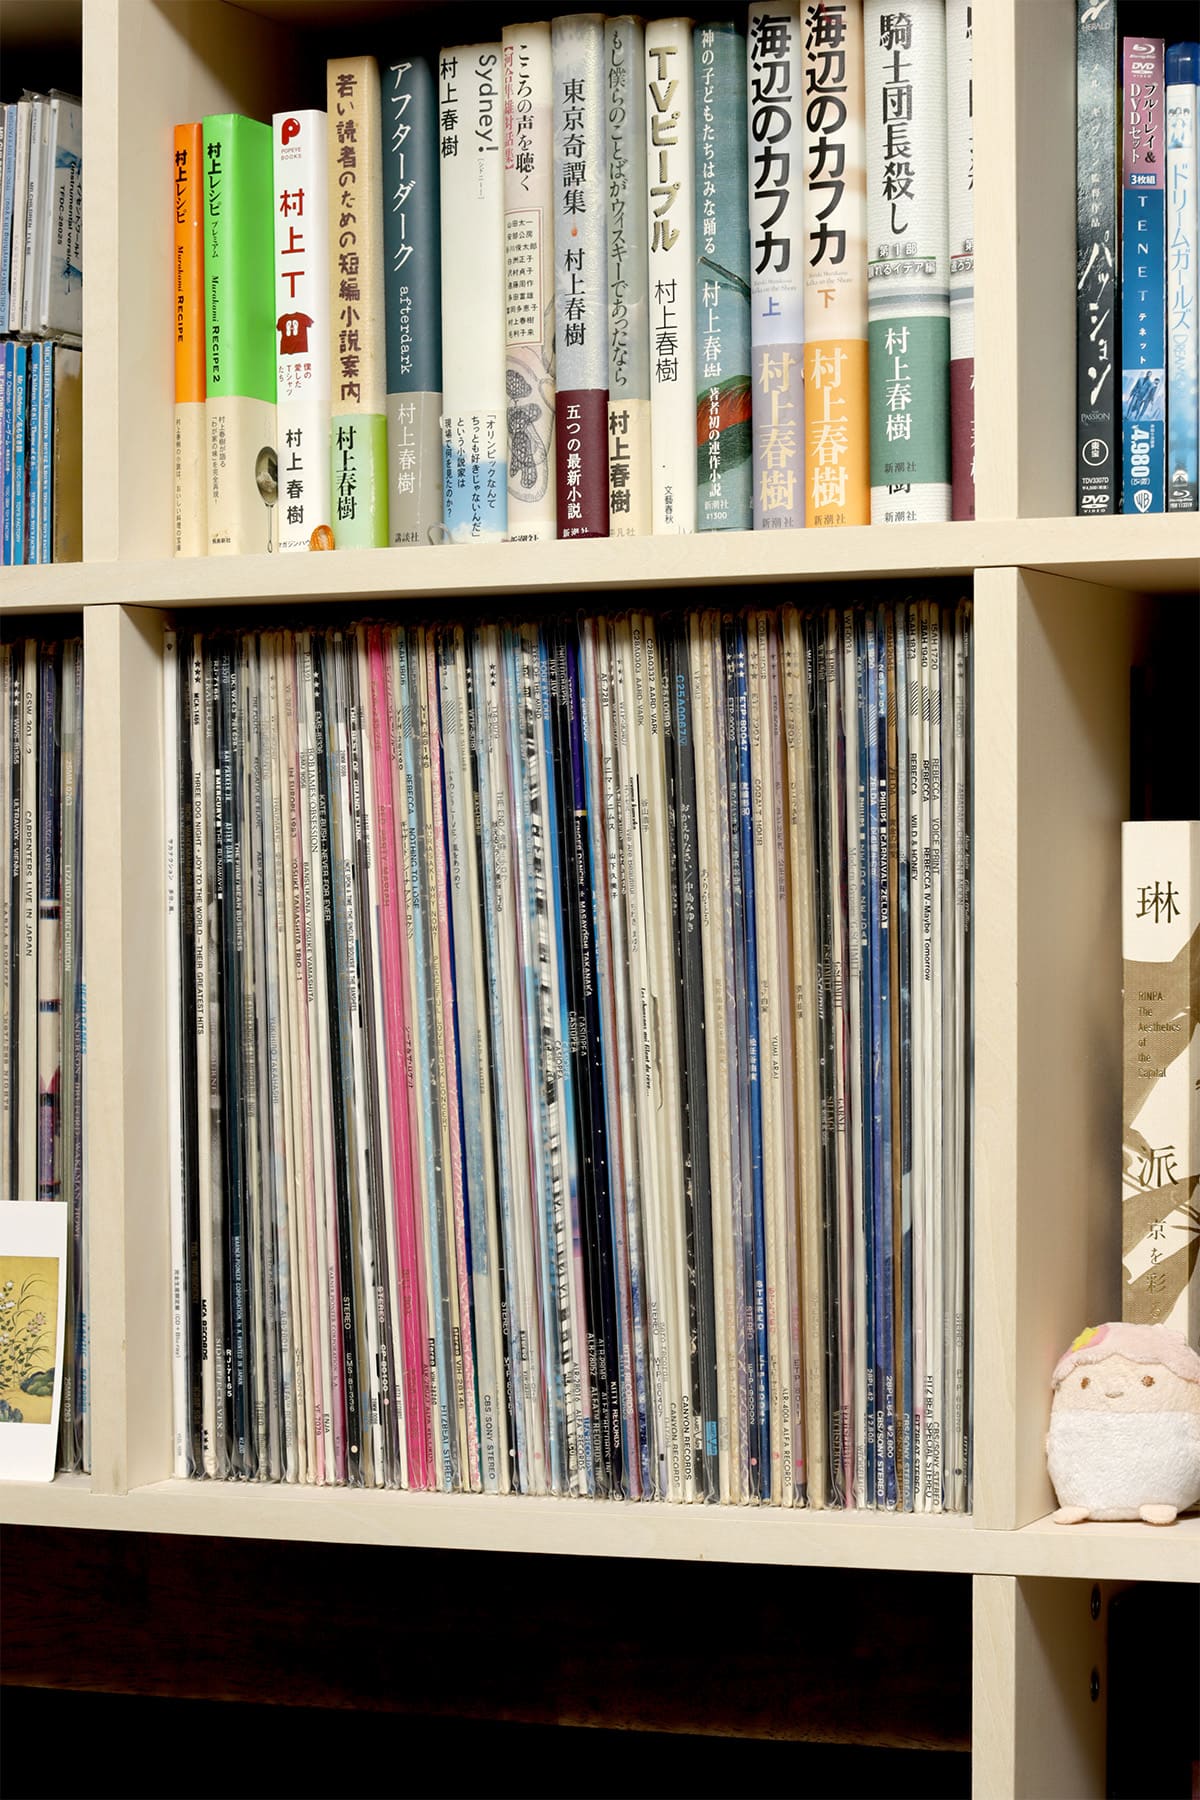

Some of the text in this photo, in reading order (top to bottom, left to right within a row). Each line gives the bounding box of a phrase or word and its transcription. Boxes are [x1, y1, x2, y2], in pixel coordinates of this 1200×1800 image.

[440, 56, 458, 158] 村上春樹
[475, 54, 498, 153] Sydney!
[1132, 62, 1155, 71] DVD
[515, 44, 534, 192] こころの声を聴く
[562, 78, 587, 216] 東京奇譚集
[648, 46, 681, 253] TVピープル
[701, 30, 716, 254] 神の子どもたちはみな踊る
[751, 14, 792, 275] 海辺のカフカ
[805, 3, 848, 267] 海辺のカフカ
[879, 12, 916, 234] 騎士団長殺し
[1129, 84, 1142, 164] DVDセット
[1142, 84, 1158, 164] ブルーレイ&
[175, 150, 188, 224] 村上レシピ
[208, 142, 222, 216] 村上レシピ
[390, 62, 416, 272] アフターダーク
[608, 30, 628, 386] もし僕らのことばがウィスキーであったなら
[1130, 174, 1156, 185] 3枚組
[280, 188, 305, 298] 村上T
[336, 74, 362, 404] 若い読者のための短編小説案内
[1170, 163, 1193, 330] ドリームガールズ
[212, 275, 220, 383] Murakami RECIPE 2
[399, 286, 413, 374] afterdark
[564, 248, 586, 348] 村上春樹
[654, 278, 678, 383] 村上春樹
[762, 296, 781, 317] 上
[817, 289, 836, 308] 下
[1077, 230, 1112, 406] パッション
[1138, 312, 1148, 365] テネット
[294, 363, 302, 388] 愛した
[885, 326, 912, 442] 村上春樹
[398, 402, 416, 496] 村上春樹
[456, 418, 466, 488] という小説家は
[486, 414, 496, 508] 「オリンピックなんて
[566, 404, 582, 520] 五つの最新小説
[610, 410, 631, 514] 村上春樹
[708, 387, 722, 498] 著者初の連作小説
[758, 352, 796, 512] 村上春樹
[810, 347, 848, 508] 村上春樹
[884, 462, 917, 473] 新潮社
[286, 428, 304, 525] 村上春樹
[336, 426, 358, 521] 村上春樹
[472, 416, 481, 538] ちっとも好きじゃないんだ」
[884, 510, 918, 522] 新潮社
[1082, 494, 1110, 504] DVD
[762, 516, 794, 528] 新潮社
[814, 514, 846, 525] 新潮社
[921, 619, 929, 667] 28AH 1940
[352, 761, 358, 772] OF
[739, 696, 747, 751] ETP-80047
[922, 760, 930, 802] REBECCA
[196, 873, 202, 885] TO
[406, 774, 420, 909] REBECCA NOTHING TO LOSE
[932, 849, 940, 874] PRINT
[26, 909, 32, 918] IN
[303, 862, 311, 914] BANSLIKANA
[1136, 880, 1180, 924] 琳
[569, 1011, 577, 1053] CASIOPEA
[1138, 1007, 1153, 1016] The
[1138, 1022, 1182, 1032] Aesthetics
[1138, 1038, 1148, 1046] of
[1138, 1054, 1151, 1062] the
[1137, 1145, 1178, 1188] 派
[610, 1381, 620, 1448] KITTY RECORDS
[876, 1410, 885, 1496] CBS/SONY STEREO
[925, 1375, 933, 1498] FITZ BEAT SPECIAL STEREO
